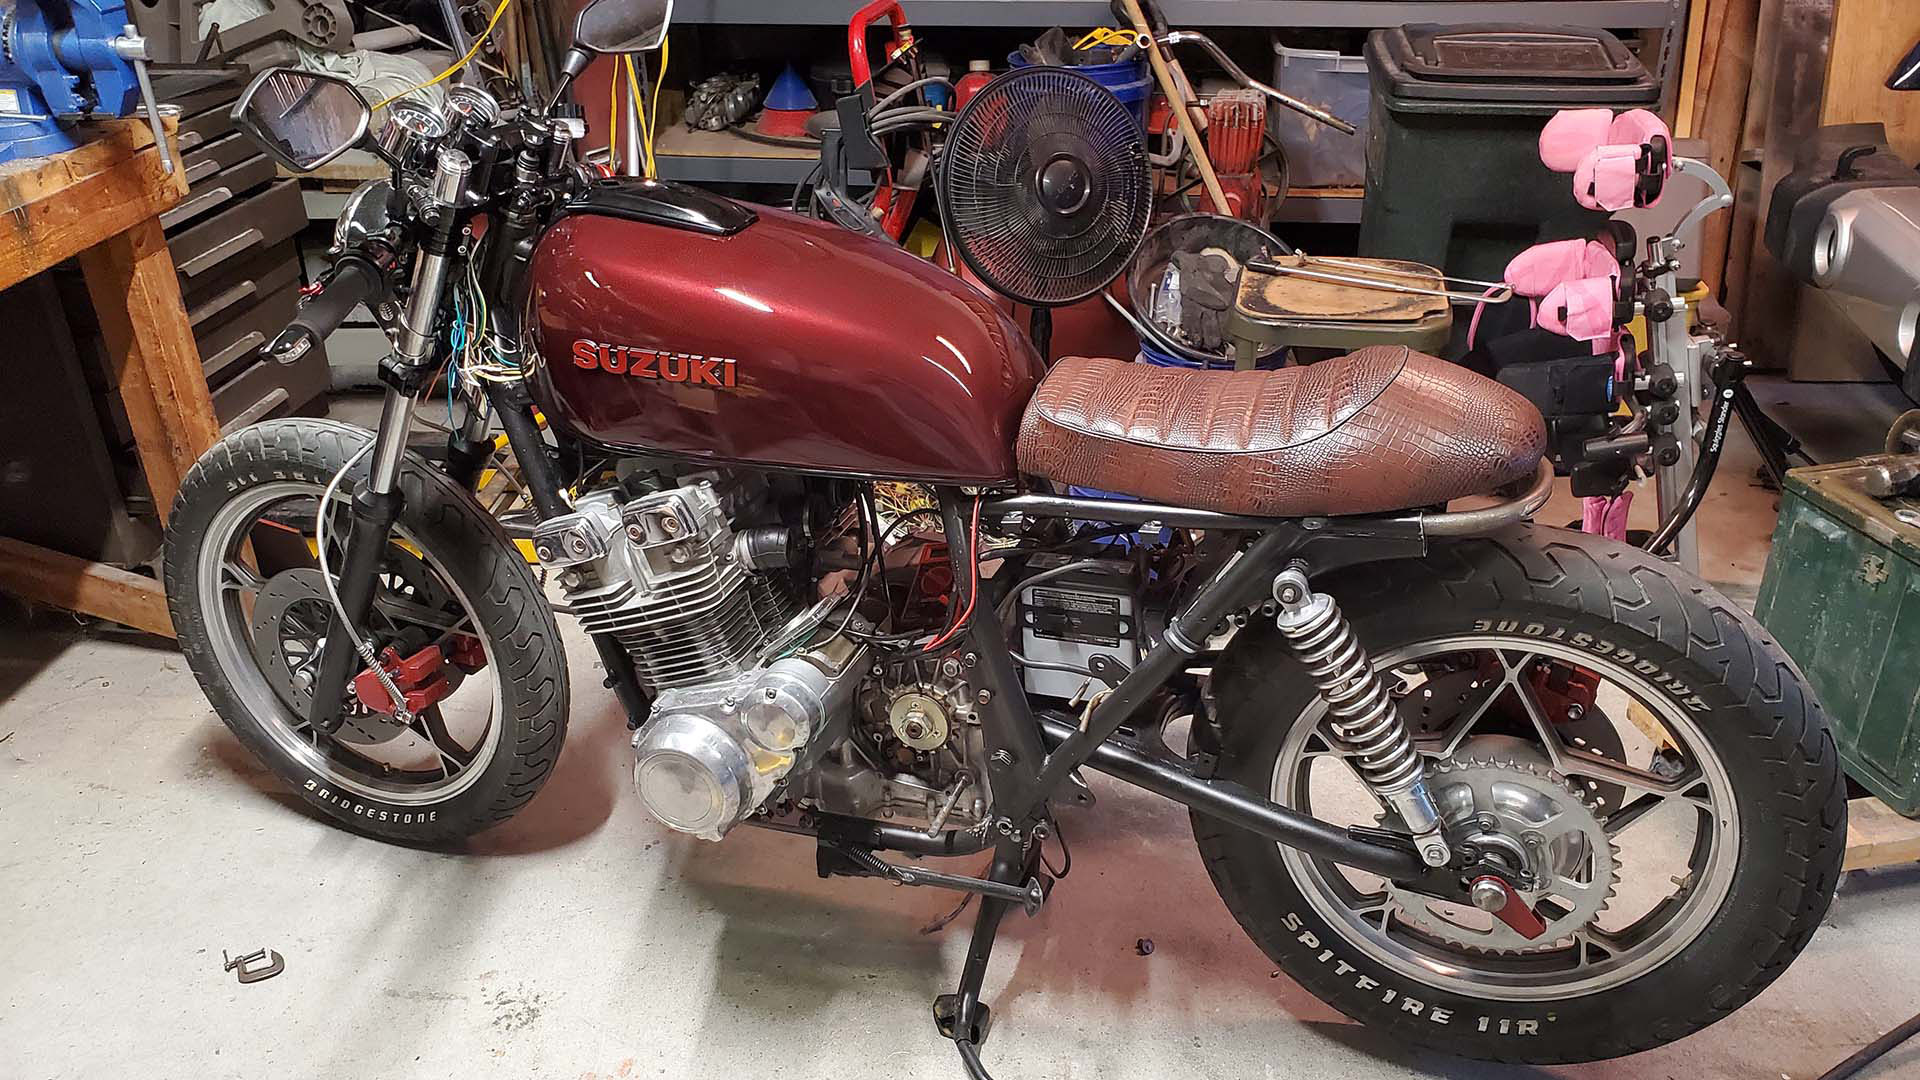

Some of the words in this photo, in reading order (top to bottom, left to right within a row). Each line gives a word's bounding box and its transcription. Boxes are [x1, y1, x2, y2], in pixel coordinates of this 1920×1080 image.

[572, 338, 737, 387] SUZUKI
[1709, 424, 1724, 453] Squiggles
[1717, 400, 1730, 424] Stander
[1472, 619, 1713, 713] BRIDGESTONE
[303, 779, 437, 824] BRIDGESTONE
[1280, 912, 1455, 1025] SPITFIRE
